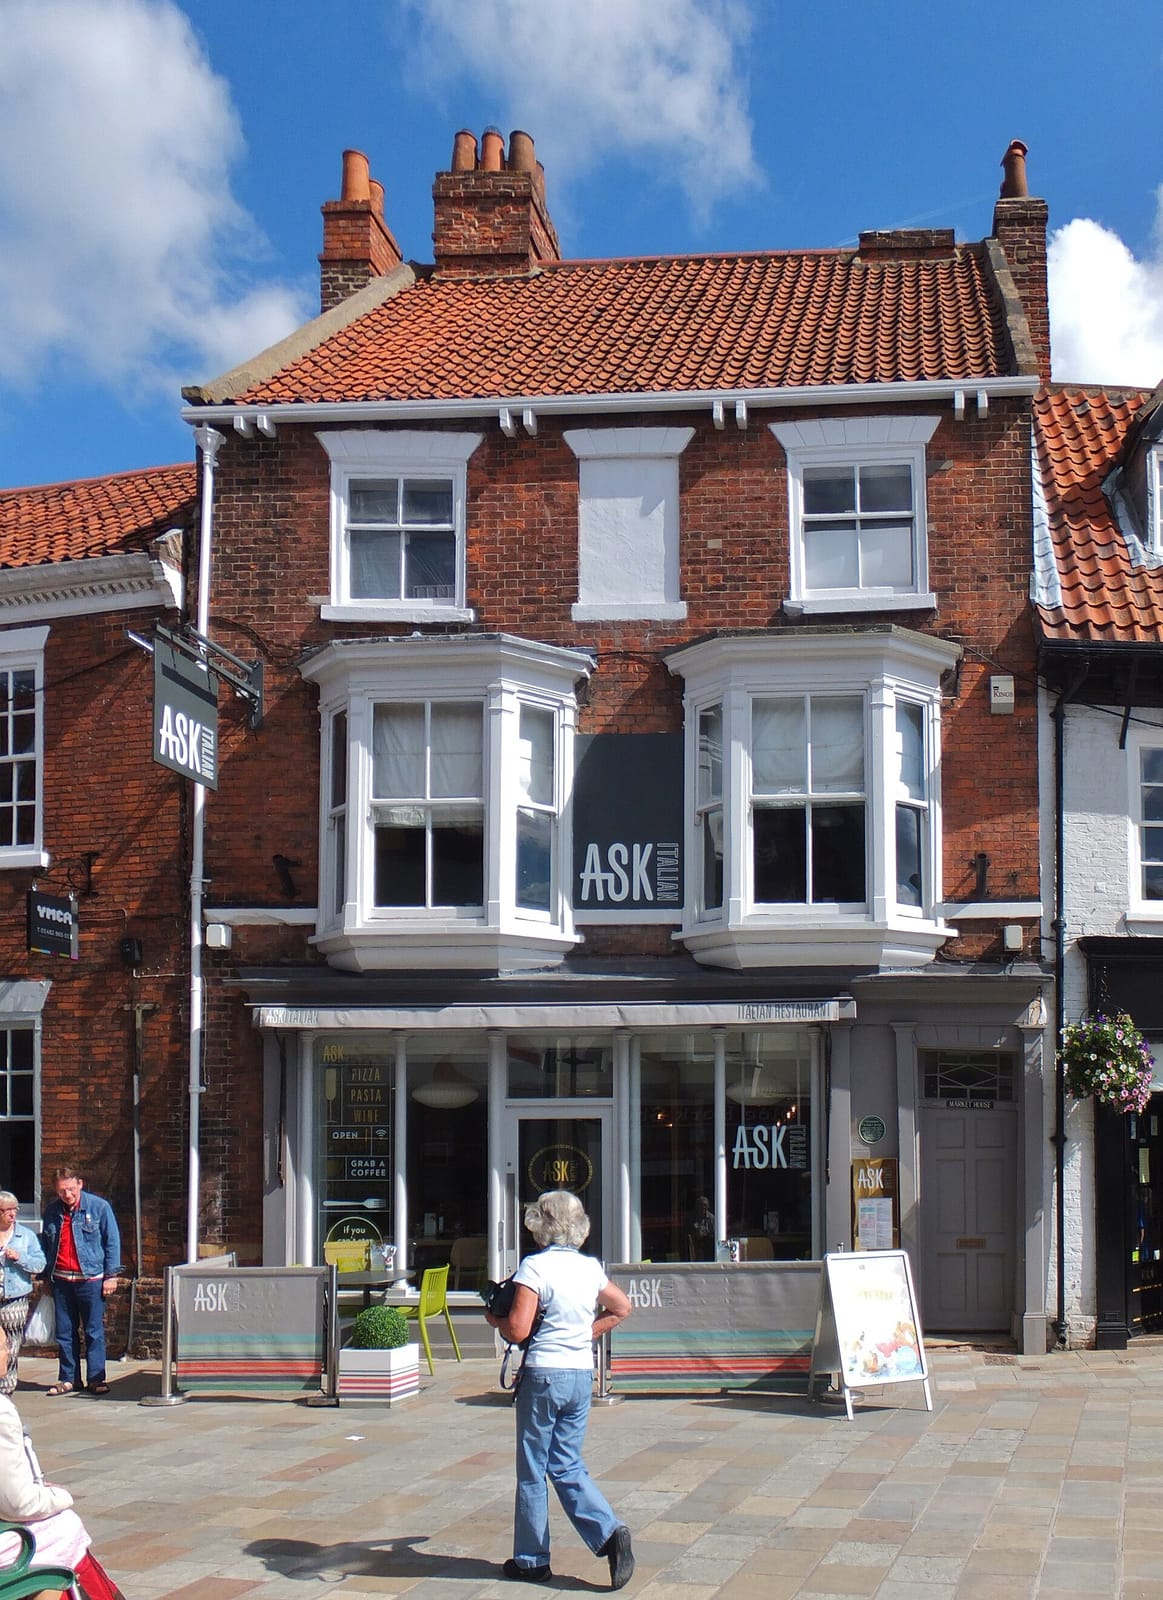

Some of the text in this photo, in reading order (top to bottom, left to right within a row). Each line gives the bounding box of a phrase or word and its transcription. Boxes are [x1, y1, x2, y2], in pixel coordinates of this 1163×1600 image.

[160, 704, 201, 774] ASK
[202, 726, 214, 780] ITALIAN
[579, 843, 654, 902] ASK
[656, 842, 679, 901] ITALIAN
[37, 905, 72, 925] YMCA
[737, 1001, 831, 1019] ITALIAN RESTAURANT
[323, 1045, 344, 1062] ASK
[351, 1068, 380, 1081] PIZZA
[350, 1088, 382, 1102] PASTA
[353, 1109, 379, 1123] WINE
[332, 1131, 359, 1140] OPEN
[732, 1125, 788, 1169] ASK
[789, 1124, 807, 1169] ITALIAN
[350, 1160, 385, 1168] GRAB A
[350, 1168, 386, 1177] COFFEE
[543, 1160, 569, 1182] ASK
[858, 1167, 884, 1189] ASK
[351, 1227, 366, 1236] you
[194, 1283, 228, 1312] ASK
[627, 1279, 662, 1308] ASK
